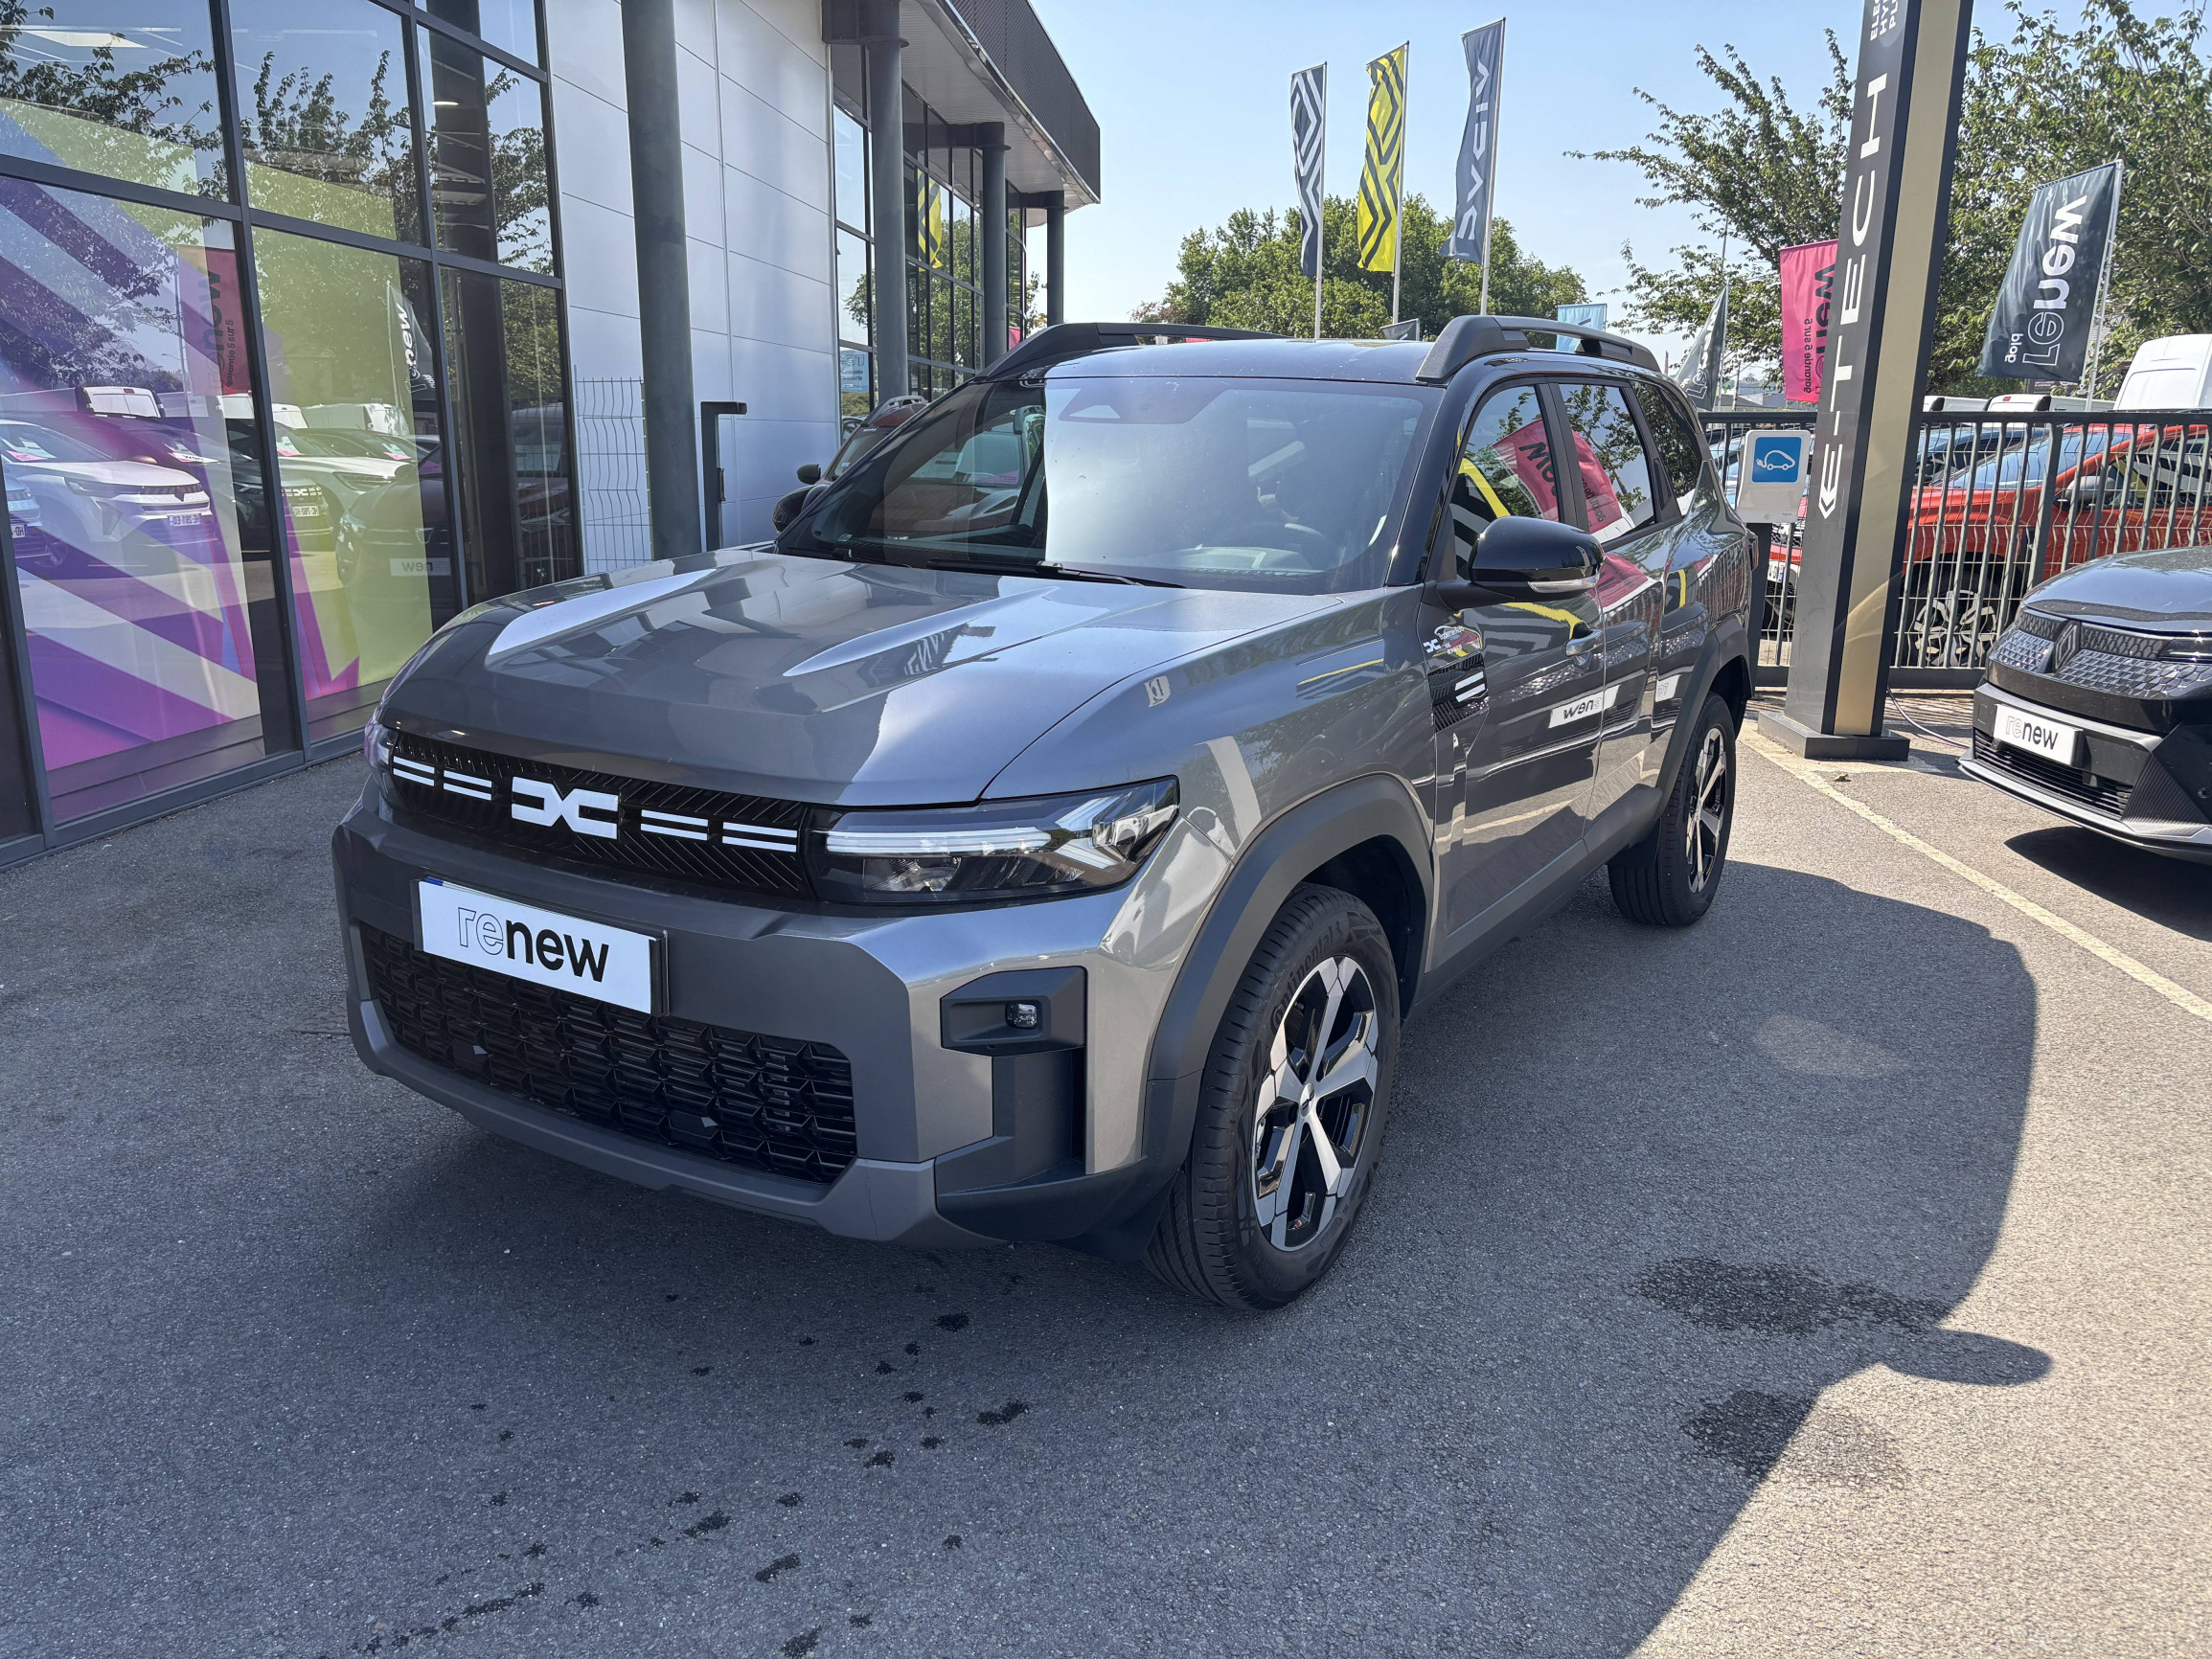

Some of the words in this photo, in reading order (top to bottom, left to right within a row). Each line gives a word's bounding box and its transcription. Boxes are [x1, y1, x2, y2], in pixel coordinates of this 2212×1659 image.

[1818, 72, 1888, 519] E-TECH
[2006, 715, 2059, 750] renew
[457, 906, 610, 983] renew
